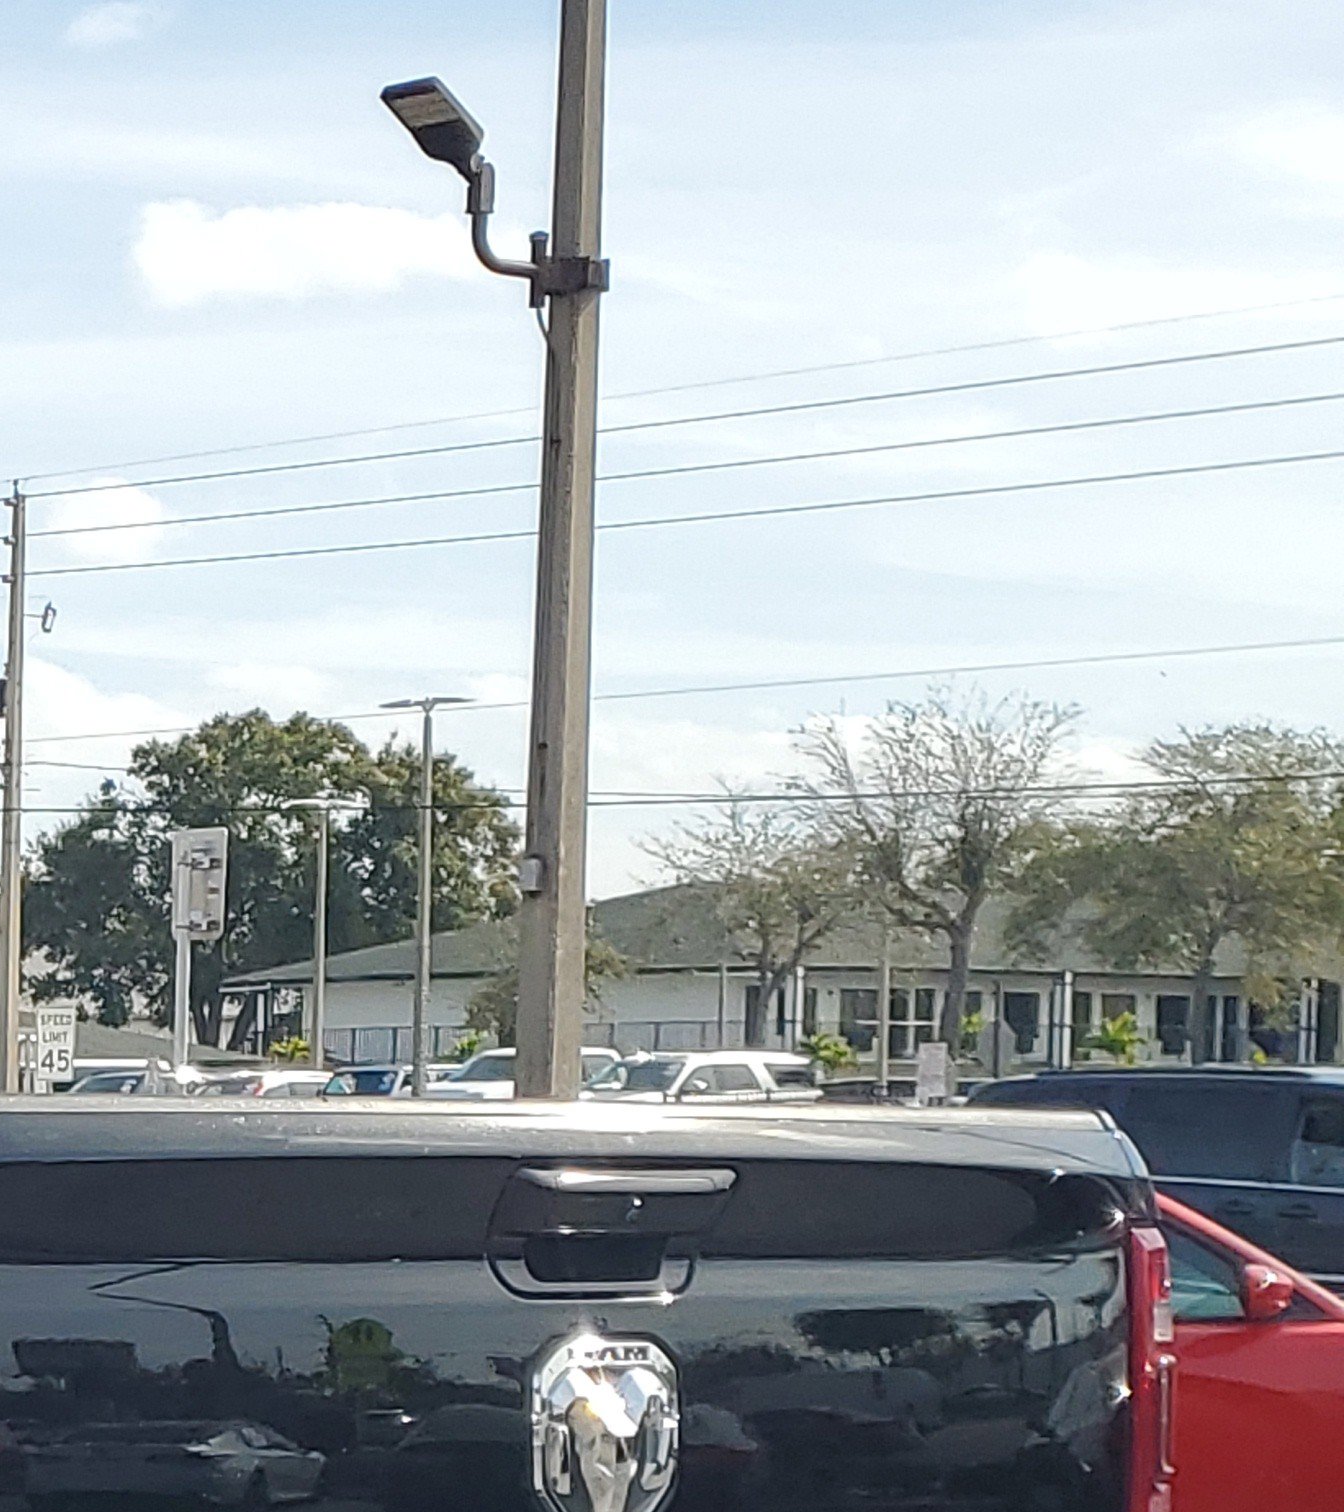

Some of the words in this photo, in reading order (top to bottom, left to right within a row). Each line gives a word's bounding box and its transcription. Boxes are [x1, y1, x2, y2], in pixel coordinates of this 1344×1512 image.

[40, 1013, 72, 1026] SPEED
[42, 1030, 68, 1044] LIMIT
[40, 1048, 70, 1073] 45
